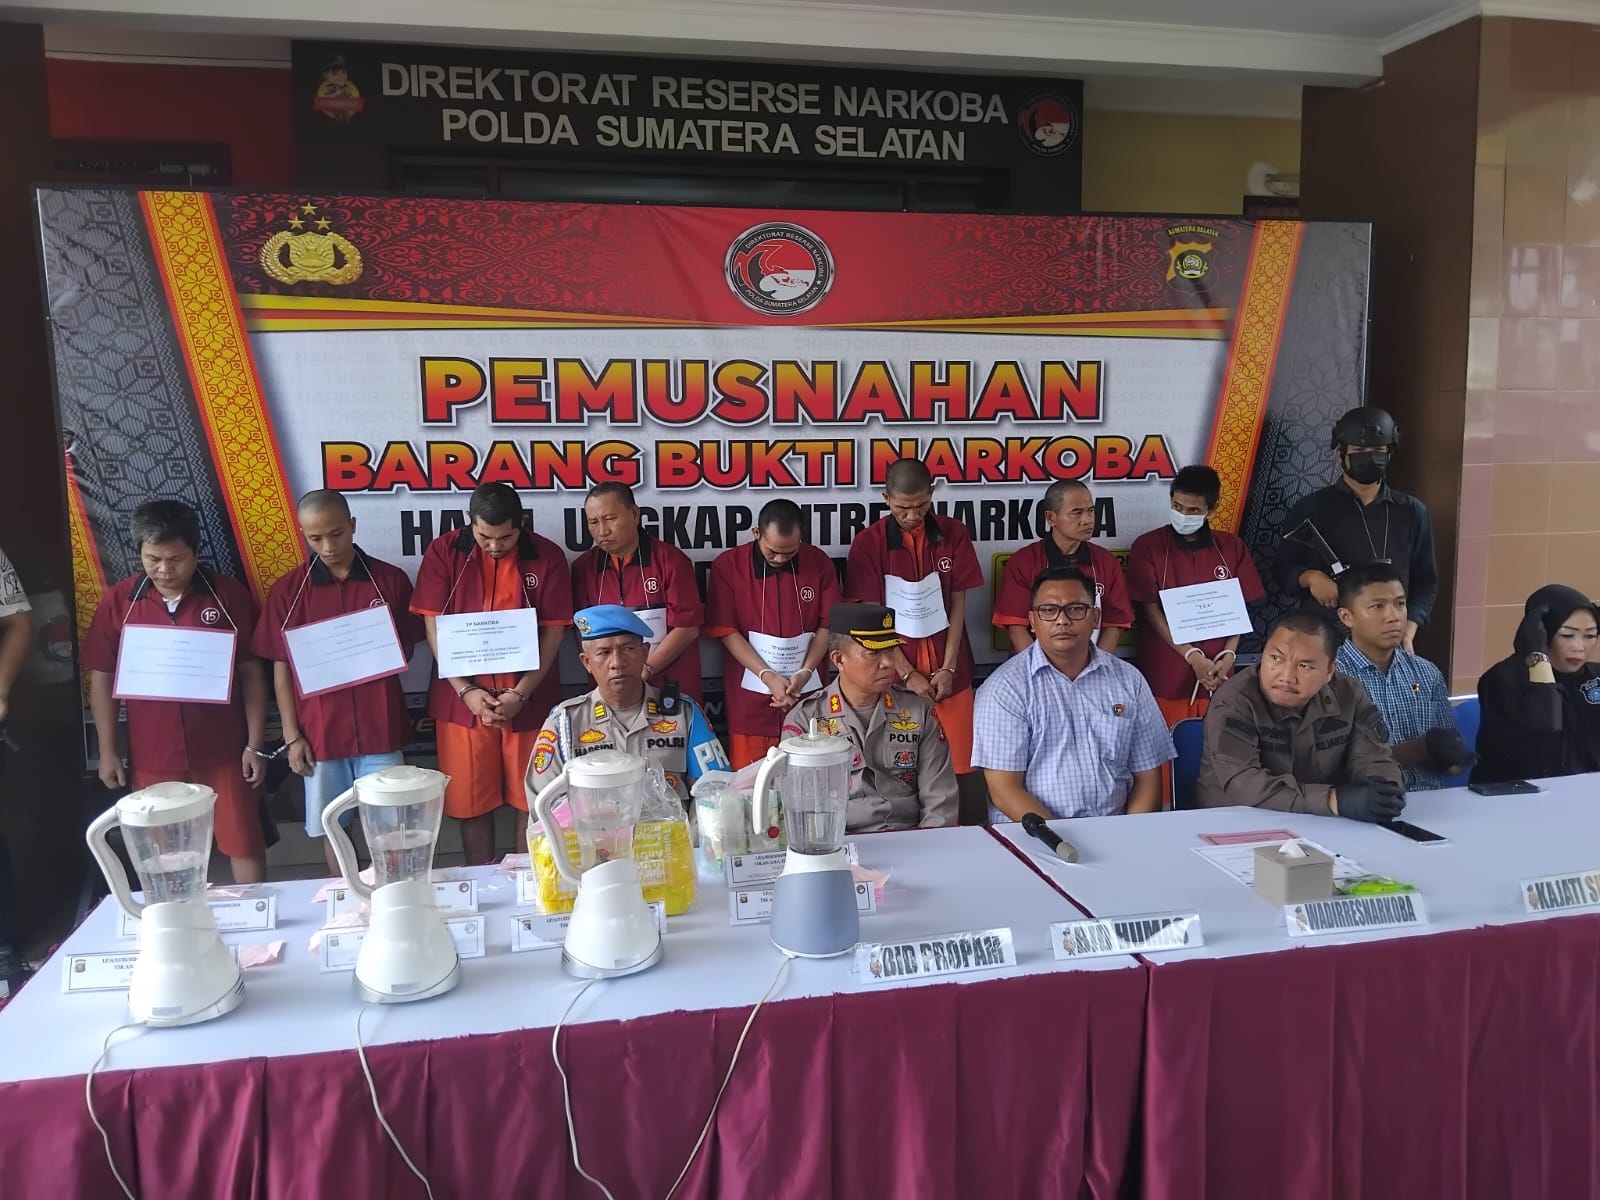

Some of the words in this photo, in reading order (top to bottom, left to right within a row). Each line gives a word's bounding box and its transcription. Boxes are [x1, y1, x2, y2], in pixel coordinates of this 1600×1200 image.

[380, 63, 637, 107] DIREKTORAT
[651, 76, 822, 115] RESERSE
[833, 85, 1009, 125] NARKOBA
[442, 109, 579, 146] POLDA
[596, 115, 800, 155] SUMATERA
[814, 124, 966, 161] SELATAN
[1168, 226, 1196, 235] SUMATERA
[1197, 226, 1219, 237] SELATAN
[745, 231, 785, 249] DIREKTORAT
[785, 232, 814, 250] RESERSE
[812, 249, 825, 278] NARKOBA
[745, 288, 763, 303] POLDA
[798, 286, 819, 304] SELATAN
[420, 356, 1103, 426] PEMUSNAHAN
[321, 439, 642, 492] BARANG
[655, 438, 855, 489] BUKTI
[869, 434, 1178, 486] NARKOBA
[563, 503, 754, 552] UGKAP
[929, 496, 1117, 542] NARKA
[939, 558, 951, 570] 12
[1217, 566, 1227, 578] 3
[525, 575, 537, 587] 19
[646, 579, 658, 592] 18
[802, 588, 813, 600] 20
[203, 609, 217, 622] 15
[647, 737, 685, 749] POLRI
[1535, 877, 1588, 909] KAJATI
[1305, 895, 1417, 930] WADIRRESNARKOBA
[920, 935, 1005, 973] PROPAM
